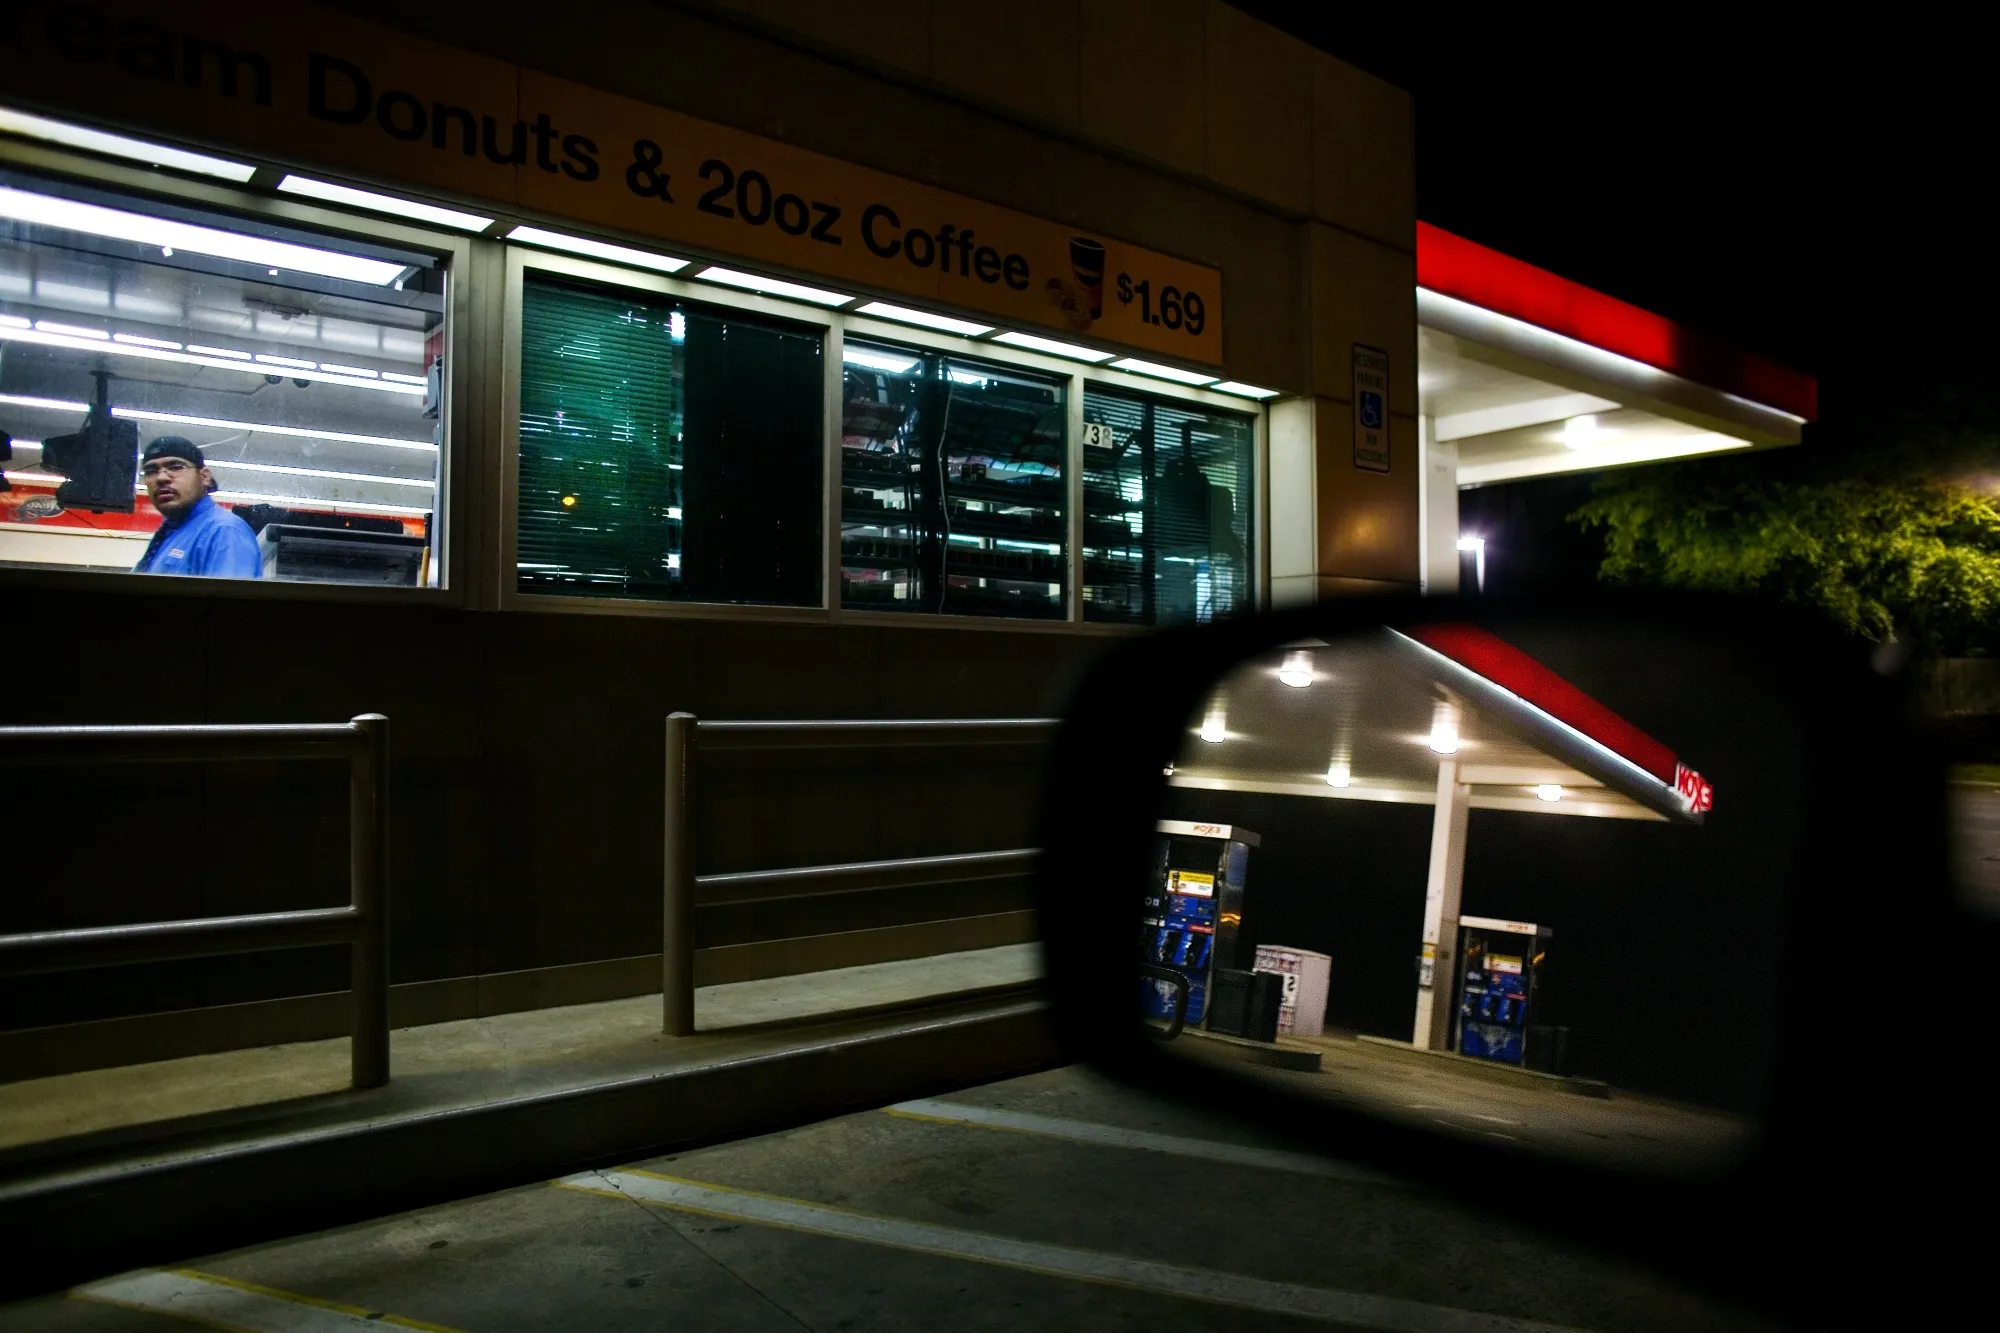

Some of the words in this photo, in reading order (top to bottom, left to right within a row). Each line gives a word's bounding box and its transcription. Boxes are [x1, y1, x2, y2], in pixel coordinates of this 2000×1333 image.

[308, 52, 599, 182] Donuts
[626, 139, 674, 203] &
[698, 159, 841, 245] 20oz
[861, 204, 1030, 290] Coffee
[1117, 271, 1205, 336] $1.69
[26, 500, 61, 511] DAIR
